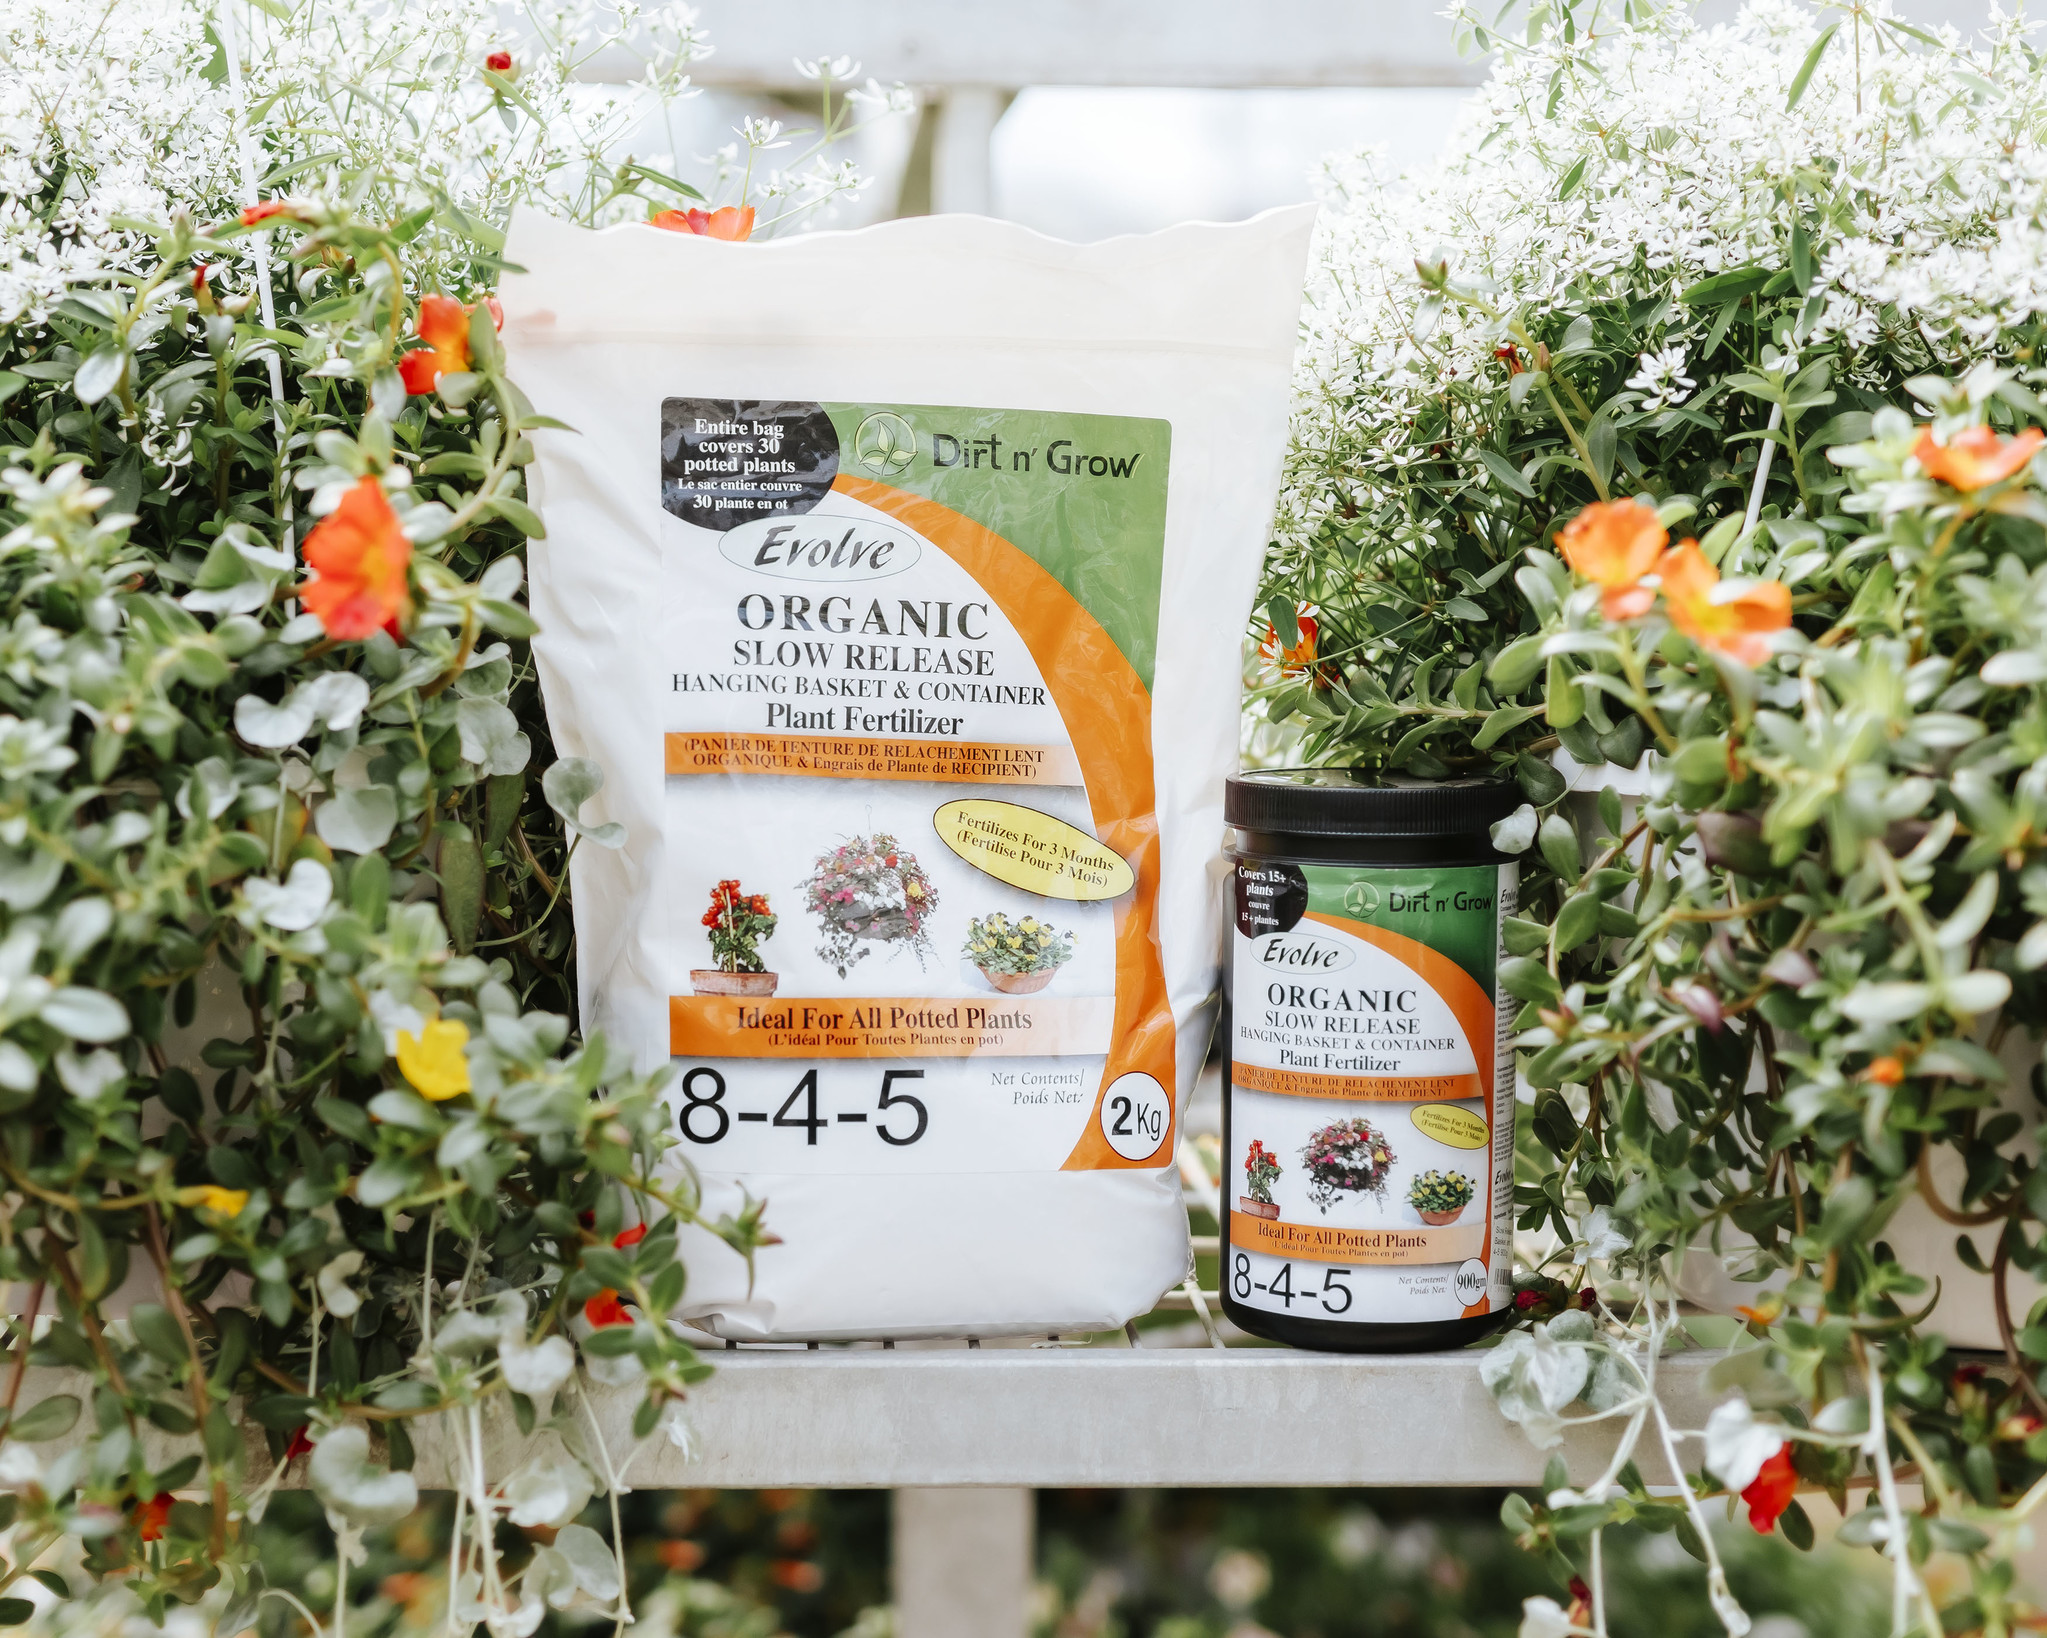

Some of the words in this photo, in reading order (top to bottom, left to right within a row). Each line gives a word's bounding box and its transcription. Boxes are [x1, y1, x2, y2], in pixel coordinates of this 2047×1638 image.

[694, 419, 748, 435] Entire
[753, 421, 784, 439] bag
[699, 441, 753, 453] covers
[758, 439, 780, 453] 30
[933, 432, 1002, 468] Dirt
[1046, 439, 1140, 480] Grow
[684, 458, 738, 475] potted
[744, 457, 796, 475] plants
[678, 479, 694, 489] Le
[697, 481, 718, 490] sac
[721, 480, 757, 491] entier
[760, 483, 802, 491] couvre
[693, 495, 712, 509] 30
[715, 498, 754, 511] plante
[757, 501, 773, 509] en
[775, 499, 788, 509] ot
[753, 524, 895, 570] Evolve
[737, 592, 989, 641] ORGANIC
[733, 640, 833, 668] SLOW
[844, 645, 995, 677] RELEASE
[672, 674, 787, 694] HANGING
[794, 676, 886, 698] BASKET
[894, 681, 910, 699] &
[918, 682, 1046, 705] CONTAINER
[766, 702, 836, 730] Plant
[842, 705, 964, 735] Fertilizer
[685, 738, 751, 752] (PANIER
[755, 739, 776, 752] DE
[779, 740, 854, 755] TENTURE
[858, 744, 879, 756] DE
[884, 745, 1001, 761] RELACHEMENT
[1005, 751, 1044, 762] LENT
[693, 753, 792, 768] ORGANIQUE
[797, 756, 808, 768] &
[814, 758, 864, 772] Engrais
[867, 760, 883, 771] de
[887, 760, 929, 773] Plante
[932, 761, 947, 773] de
[951, 762, 1037, 779] RECIPIENT)
[957, 811, 1019, 842] Fertilizes
[1022, 833, 1047, 851] For
[1049, 843, 1057, 855] 3
[1061, 847, 1114, 871] Months
[957, 829, 1016, 859] (Fertilise
[1020, 850, 1053, 871] Pour
[1055, 863, 1064, 874] 3
[1068, 867, 1108, 888] Mois)
[1239, 866, 1266, 881] Covers
[1268, 870, 1286, 883] 15+
[1246, 882, 1274, 896] plants
[1248, 901, 1270, 910] couvre
[1389, 891, 1430, 912] Dirt
[1453, 891, 1493, 912] Grow
[1255, 915, 1279, 925] plantes
[1263, 938, 1339, 968] Evolve
[1267, 982, 1417, 1013] ORGANIC
[737, 1007, 794, 1030] Ideal
[800, 1008, 843, 1030] For
[850, 1008, 882, 1029] All
[890, 1007, 959, 1029] Potted
[965, 1008, 1032, 1030] Plants
[1265, 1011, 1318, 1031] SLOW
[1324, 1016, 1421, 1035] RELEASE
[826, 1034, 858, 1046] Pour
[864, 1034, 906, 1045] Toutes
[910, 1033, 956, 1045] Plantes
[960, 1036, 974, 1045] en
[978, 1034, 1004, 1048] pot)
[1241, 1026, 1291, 1045] HANGING
[1295, 1035, 1351, 1049] BASKET
[1355, 1040, 1366, 1050] &
[1371, 1038, 1455, 1051] CONTAINER
[1280, 1050, 1318, 1068] Plant
[1323, 1054, 1401, 1071] Fertilizer
[991, 1072, 1015, 1086] Net
[679, 1067, 929, 1146] 8-4-5
[1013, 1089, 1049, 1105] Poids
[1053, 1091, 1083, 1105] Net:
[1258, 1222, 1284, 1239] Ideal
[1288, 1227, 1310, 1242] For
[1313, 1228, 1332, 1244] All
[1337, 1233, 1380, 1247] Potted
[1385, 1234, 1427, 1247] Plants
[1234, 1252, 1353, 1314] 8-4-5
[1410, 1286, 1430, 1295] Poids
